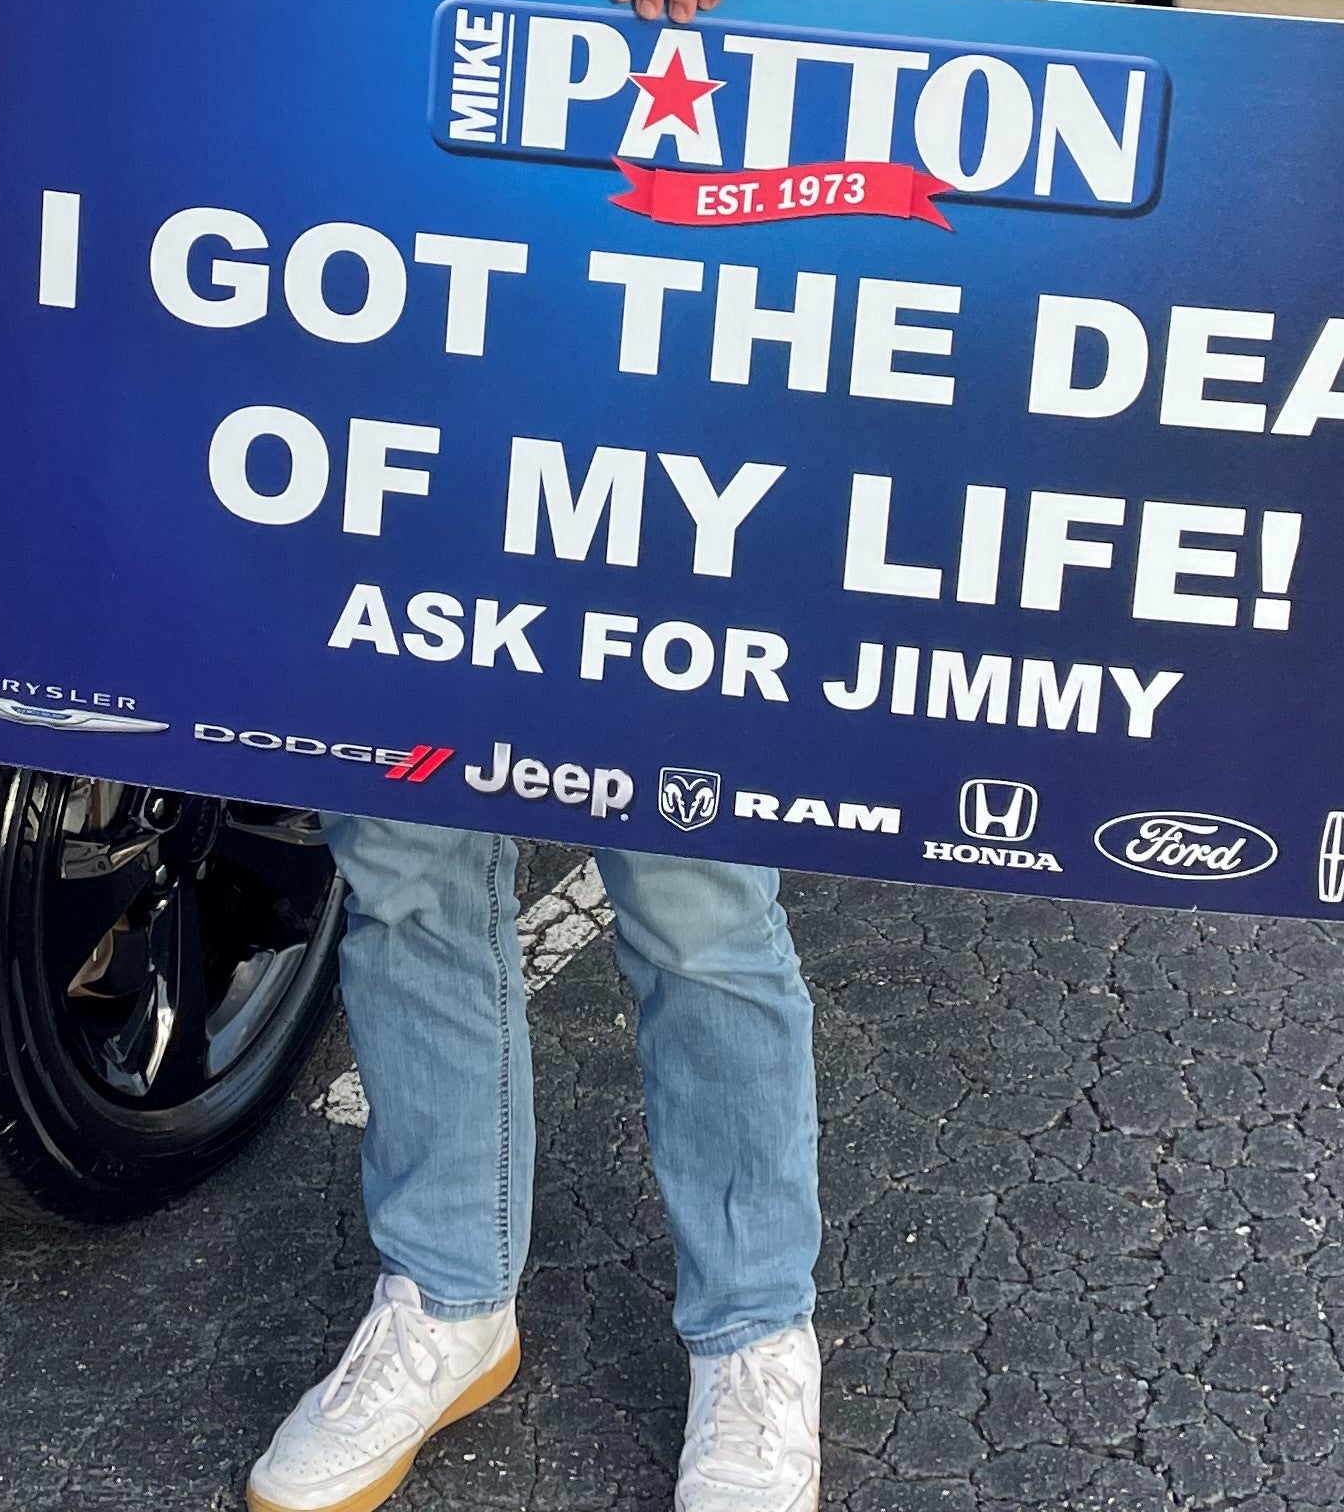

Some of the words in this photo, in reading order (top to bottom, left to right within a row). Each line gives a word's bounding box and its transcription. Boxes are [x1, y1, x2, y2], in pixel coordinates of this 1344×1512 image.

[448, 8, 505, 144] MIKE
[520, 15, 1146, 204] PATTON
[696, 182, 772, 217] EST.
[777, 172, 867, 210] 1973
[38, 189, 81, 309] I
[149, 206, 529, 357] GOT
[587, 250, 963, 406] THE
[208, 405, 441, 537] OF
[503, 436, 788, 578] MY
[842, 472, 1303, 631] LIFE!
[327, 583, 548, 674] ASK
[579, 611, 790, 703] FOR
[822, 642, 1185, 739] JIMMY
[193, 722, 417, 768] DODGE
[463, 741, 635, 819] Jeep
[734, 790, 901, 834] RAM
[922, 840, 1064, 873] HONDA
[1125, 818, 1247, 872] Ford
